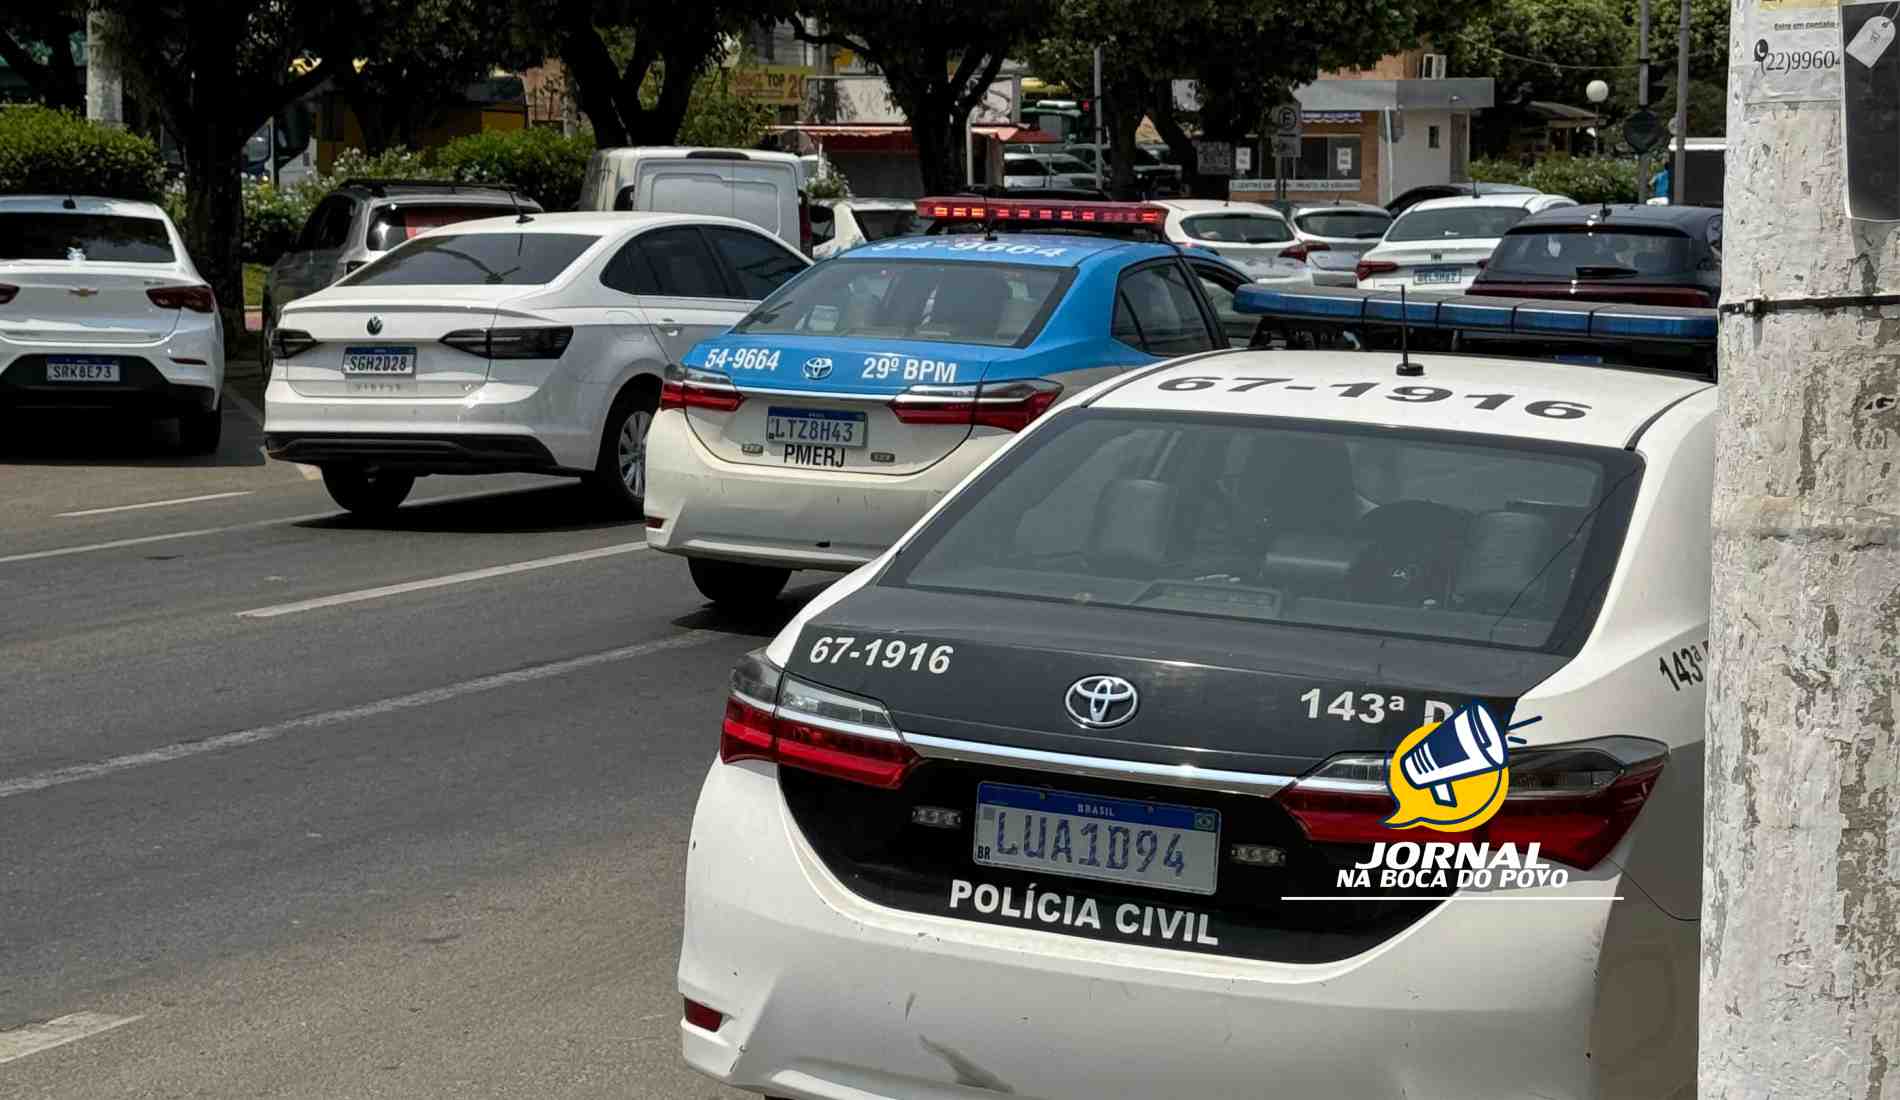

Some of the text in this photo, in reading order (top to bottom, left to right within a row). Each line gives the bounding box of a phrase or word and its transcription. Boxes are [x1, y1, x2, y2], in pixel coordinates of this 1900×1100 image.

[350, 356, 407, 371] SGH2D28
[705, 348, 781, 371] 54-9664
[903, 359, 957, 382] BPM
[1156, 376, 1593, 420] 67-1916
[775, 418, 853, 443] LTZ8H43
[783, 443, 846, 468] PMERJ
[809, 636, 953, 674] 67-1916
[1300, 687, 1453, 726] 143ª D
[1077, 803, 1115, 817] BRASIL
[977, 845, 991, 860] BR
[996, 811, 1185, 877] LUA1D94
[949, 879, 1219, 945] POLÍCIA CIVIL
